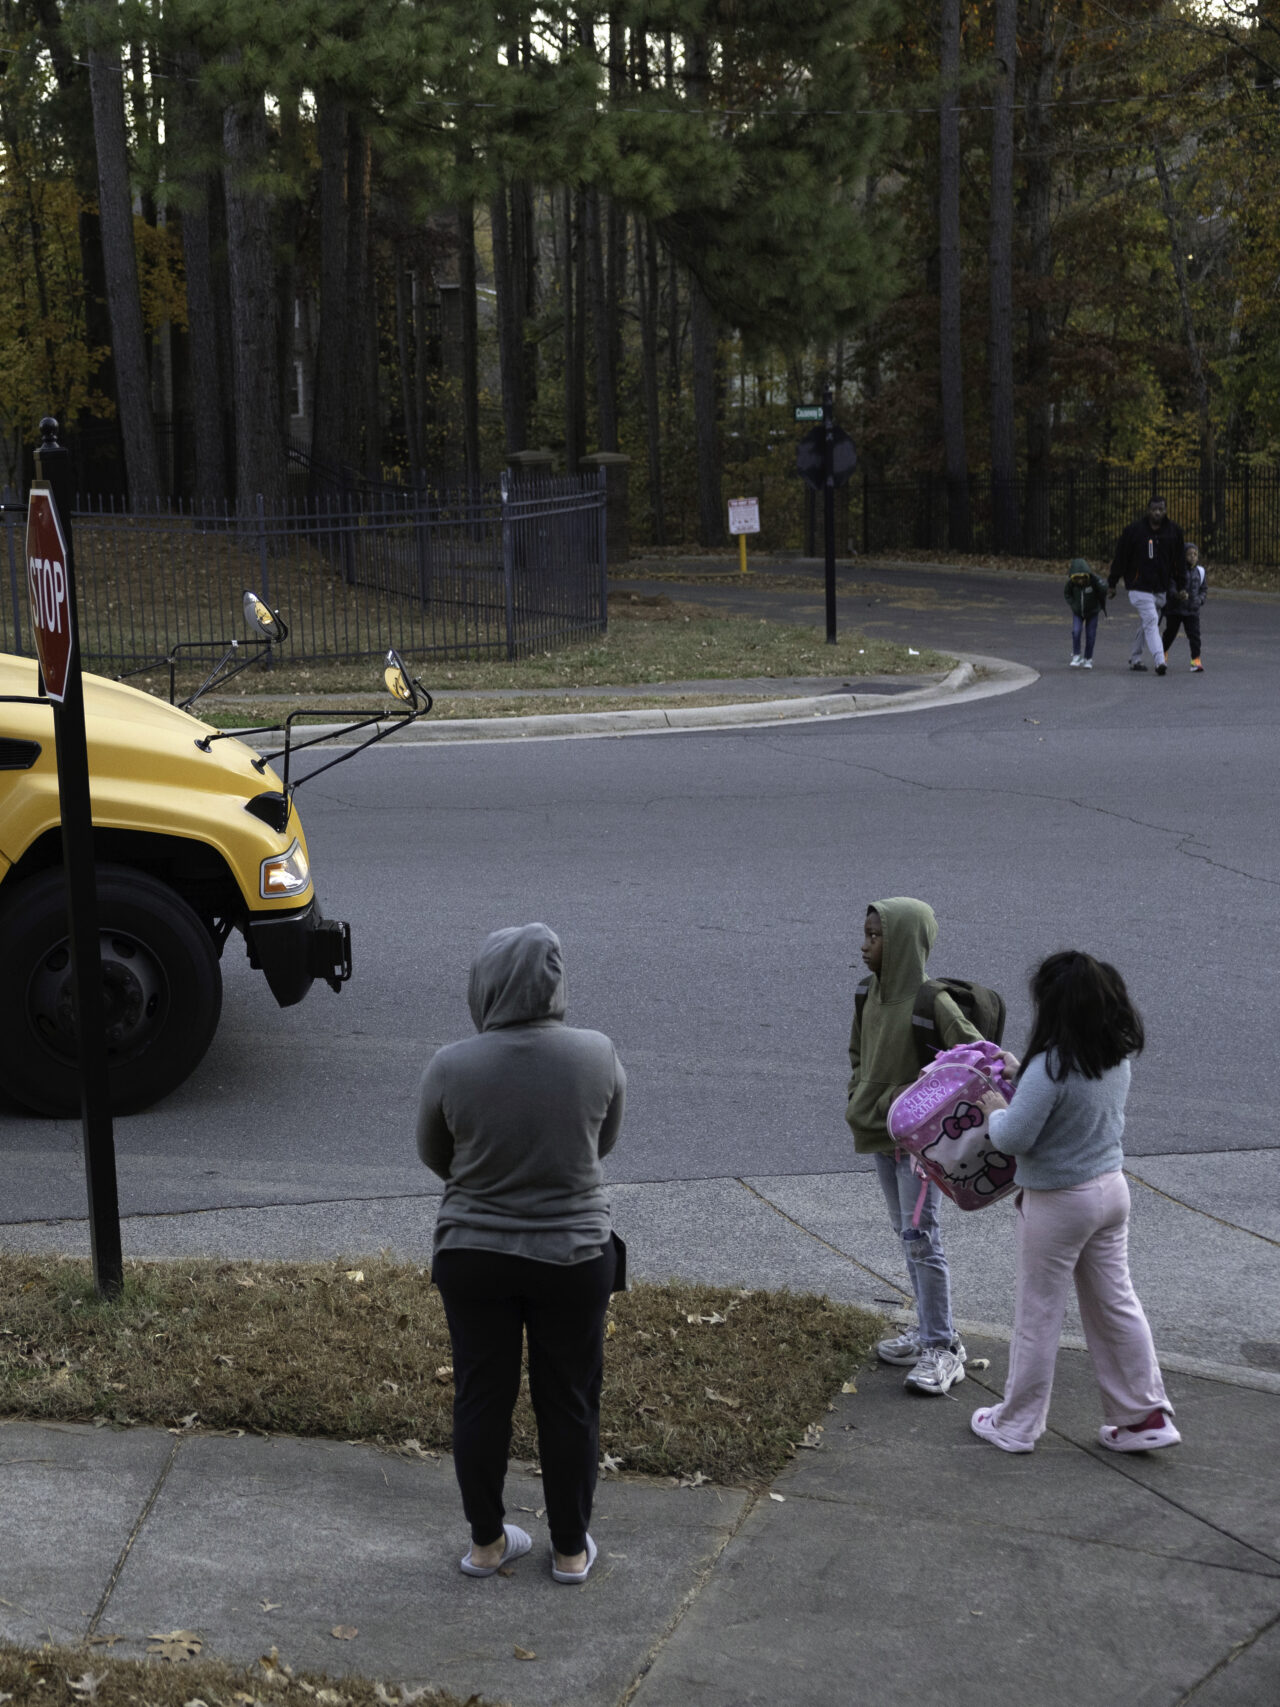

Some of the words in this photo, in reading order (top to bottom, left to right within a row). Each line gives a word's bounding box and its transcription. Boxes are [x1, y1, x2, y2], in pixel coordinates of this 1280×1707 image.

[30, 556, 65, 634] STOP
[903, 1078, 940, 1112] HELLO
[912, 1086, 947, 1119] KITTY
